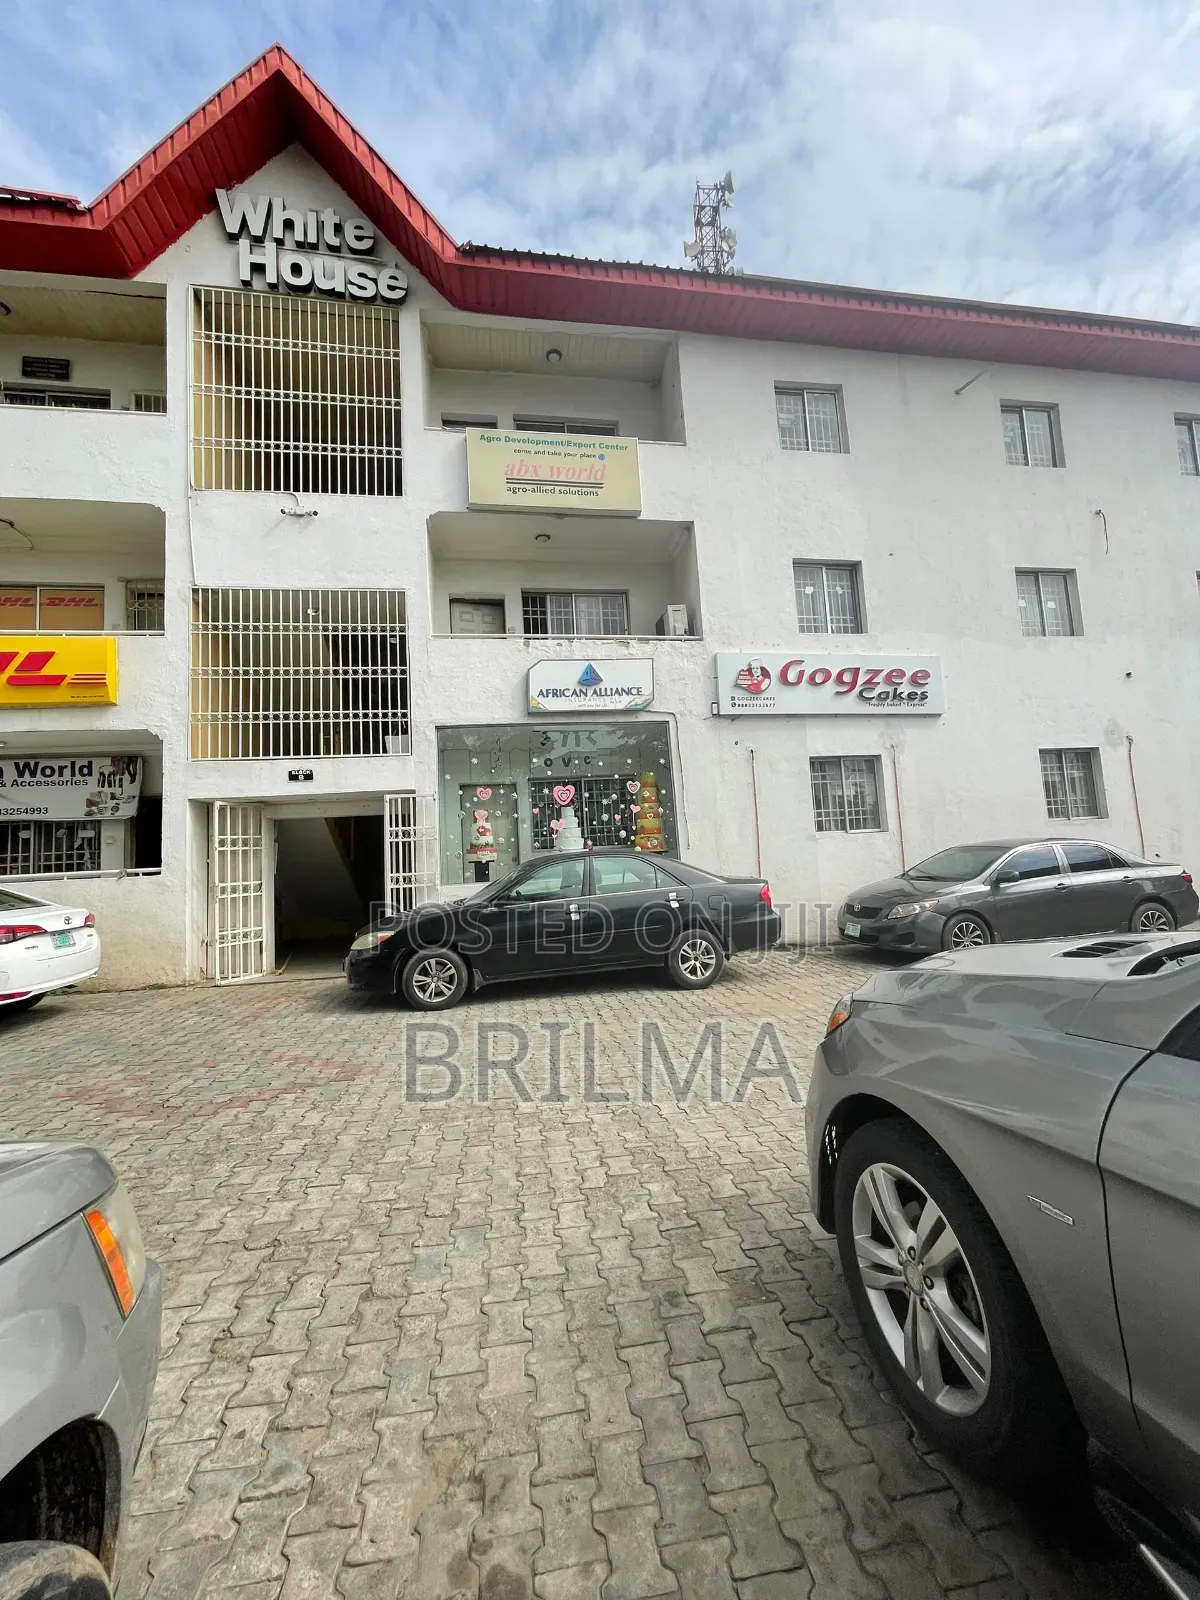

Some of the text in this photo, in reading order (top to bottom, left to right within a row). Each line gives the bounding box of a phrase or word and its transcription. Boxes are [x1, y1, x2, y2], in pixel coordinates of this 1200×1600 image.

[215, 188, 376, 254] White
[239, 238, 409, 303] House
[479, 434, 629, 451] Agro Development/Export Center
[579, 452, 597, 460] place
[504, 459, 607, 481] abx world
[506, 485, 599, 497] agro-allied solutions
[45, 597, 100, 607] DHL
[778, 659, 931, 695] Gogzee
[537, 686, 643, 698] AFRICAN ALLIANCE
[857, 687, 929, 702] Cakes
[13, 760, 93, 779] World
[10, 779, 88, 788] Accessories
